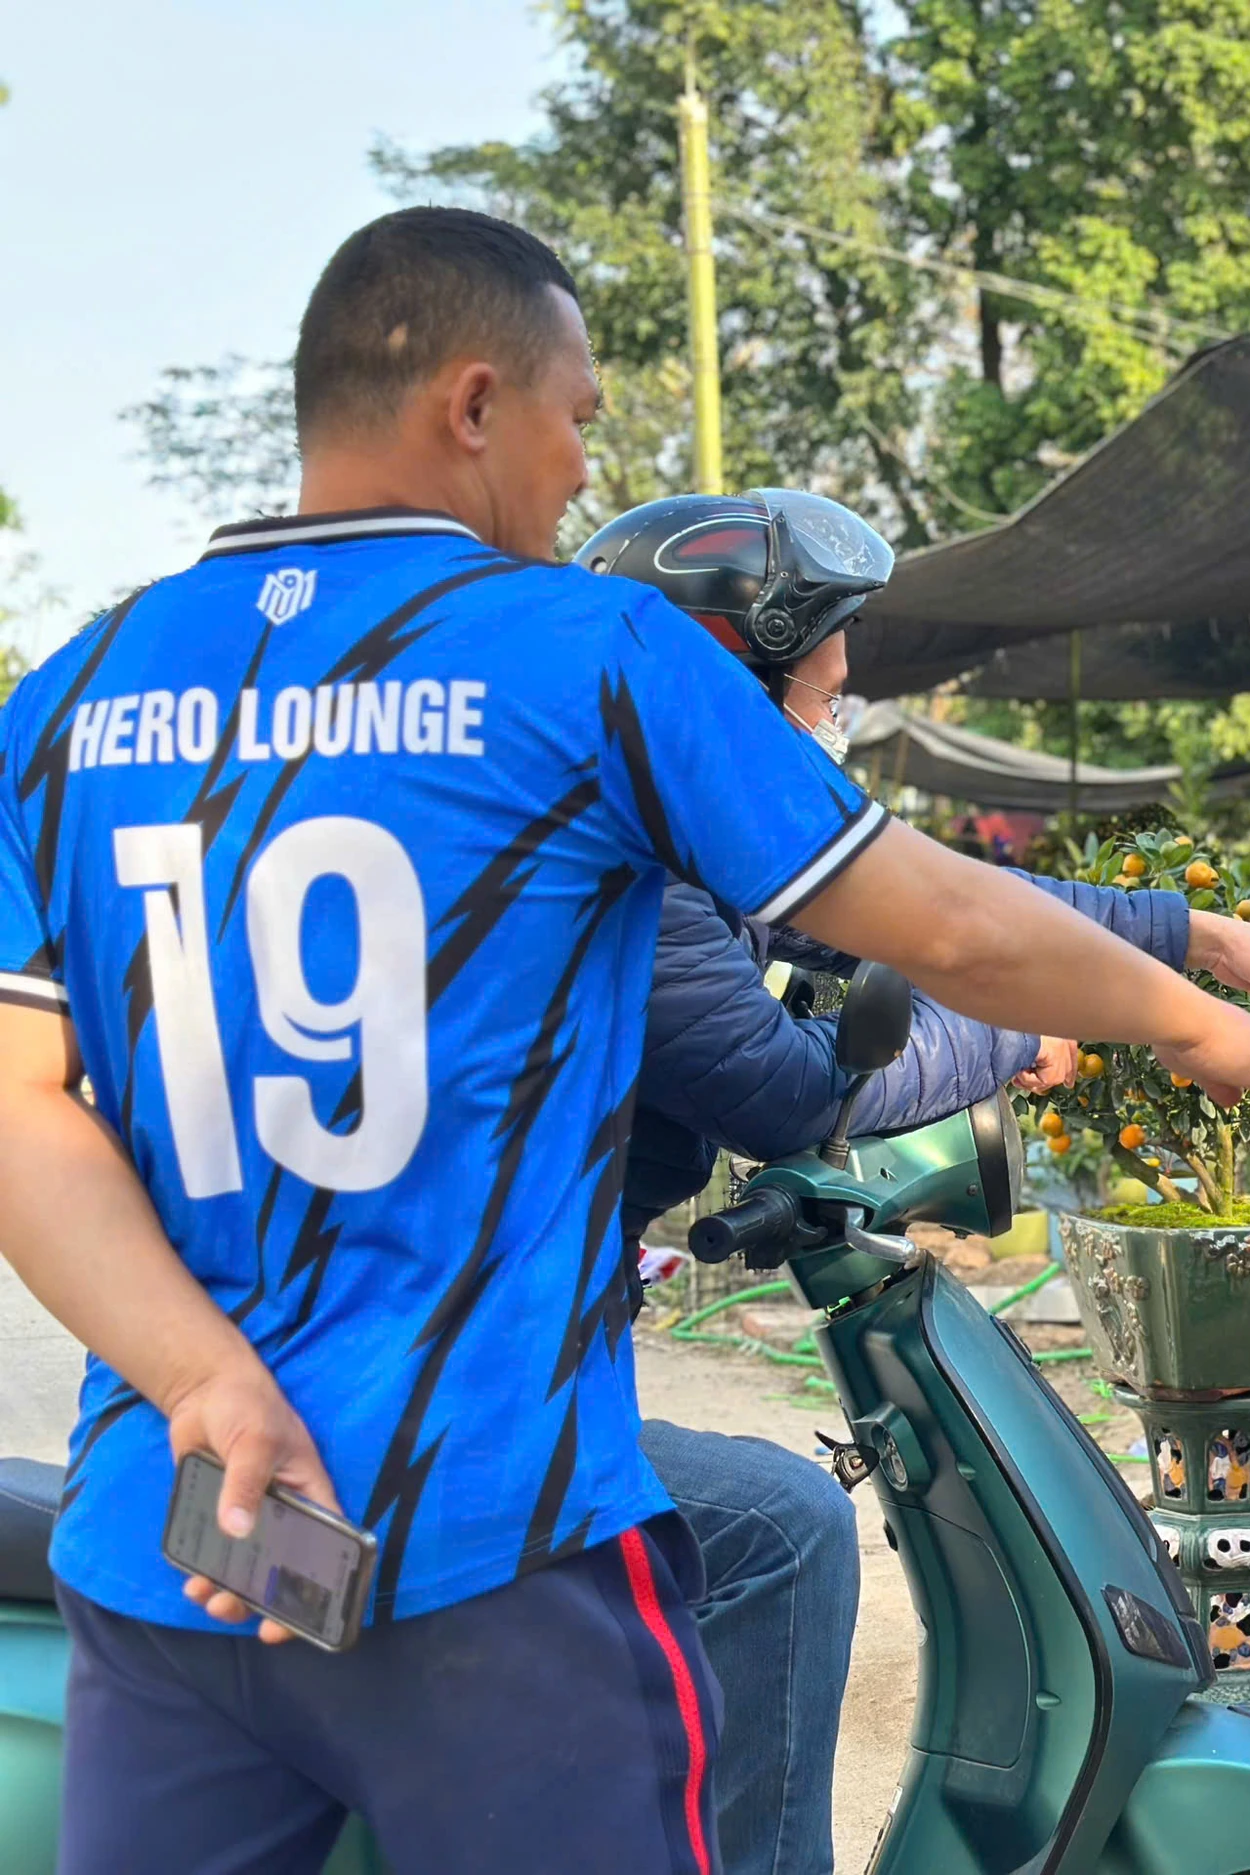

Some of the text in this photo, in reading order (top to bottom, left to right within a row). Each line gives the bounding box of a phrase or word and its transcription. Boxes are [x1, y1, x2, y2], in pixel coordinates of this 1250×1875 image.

[68, 679, 487, 772] HERO LOUNGE
[113, 815, 428, 1199] 19
